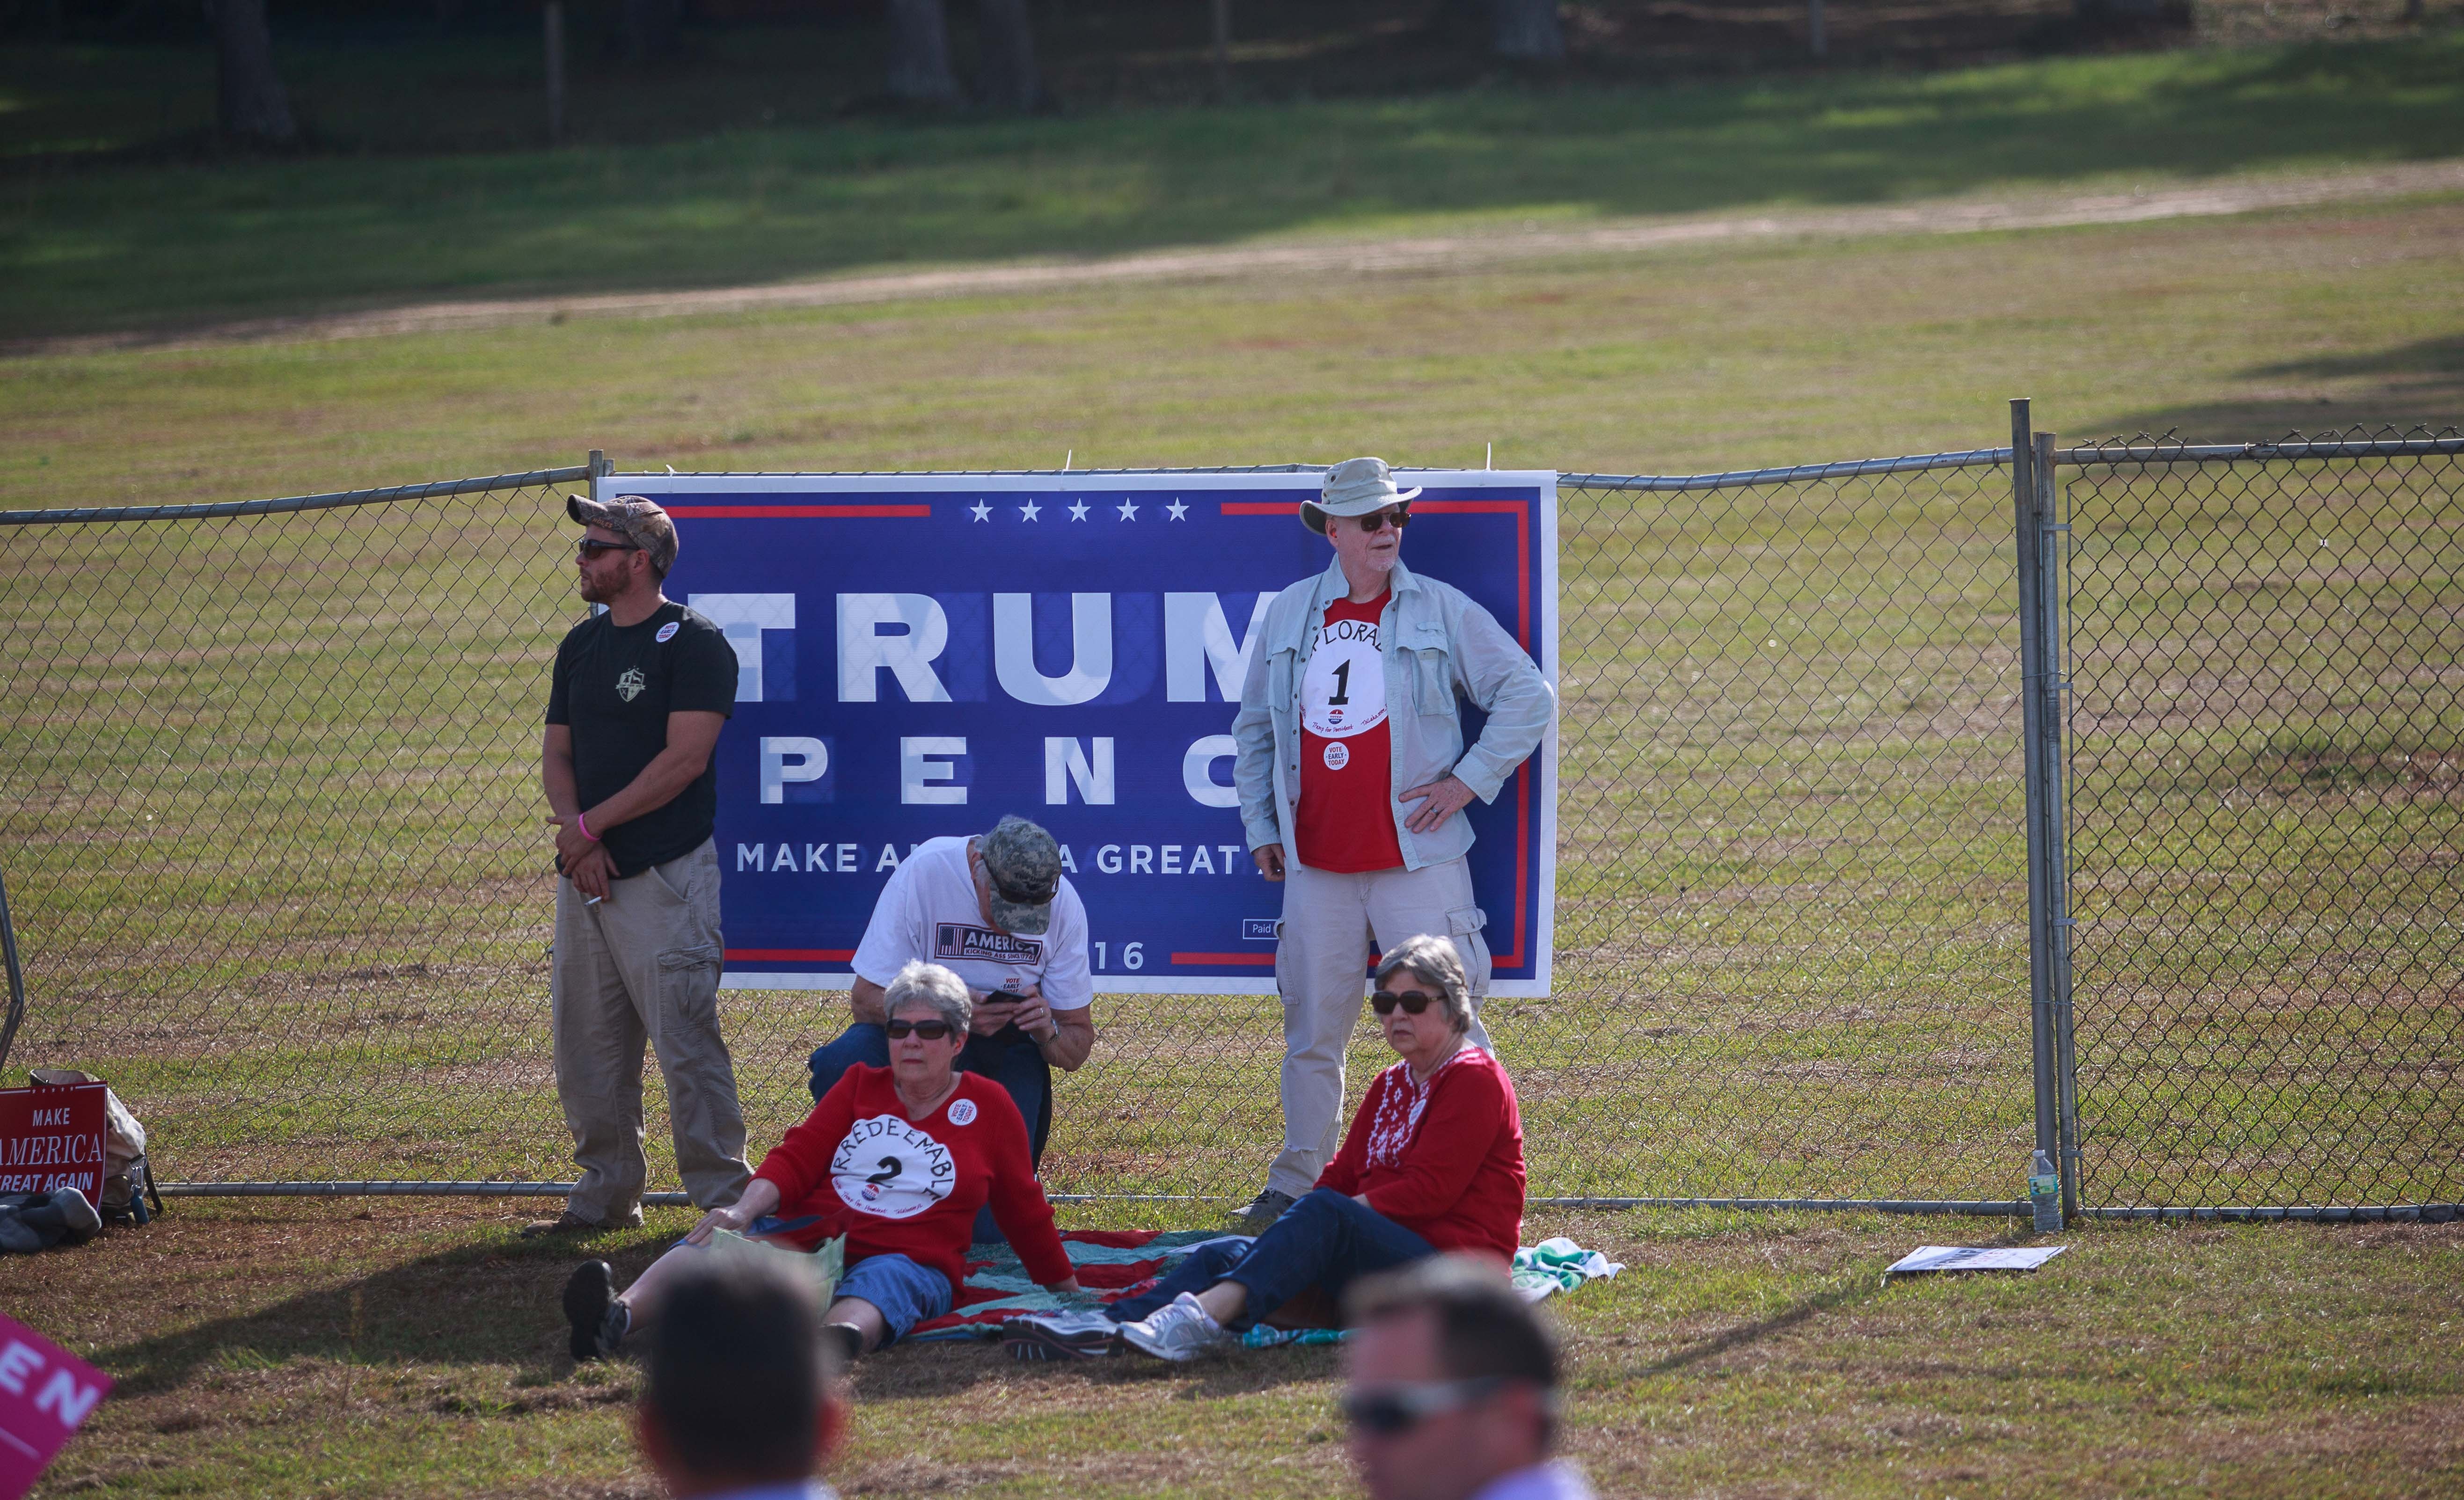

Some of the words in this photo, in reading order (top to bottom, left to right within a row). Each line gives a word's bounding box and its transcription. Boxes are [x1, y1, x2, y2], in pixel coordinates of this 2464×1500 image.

[688, 592, 1281, 706] TRUM
[1328, 659, 1350, 705] 1
[760, 735, 1241, 808] PENC
[737, 844, 857, 872] MAKE
[1097, 845, 1240, 874] GREAT
[1252, 924, 1271, 933] Paid
[965, 932, 1034, 954] AMERICA
[1095, 942, 1143, 969] 16
[32, 1107, 70, 1127] MAKE
[951, 1104, 961, 1117] VOTE
[957, 1104, 967, 1120] EARLY
[962, 1106, 974, 1122] TODAY
[0, 1174, 42, 1192] REAT
[43, 1172, 93, 1192] AGAIN
[866, 1156, 902, 1188] 2
